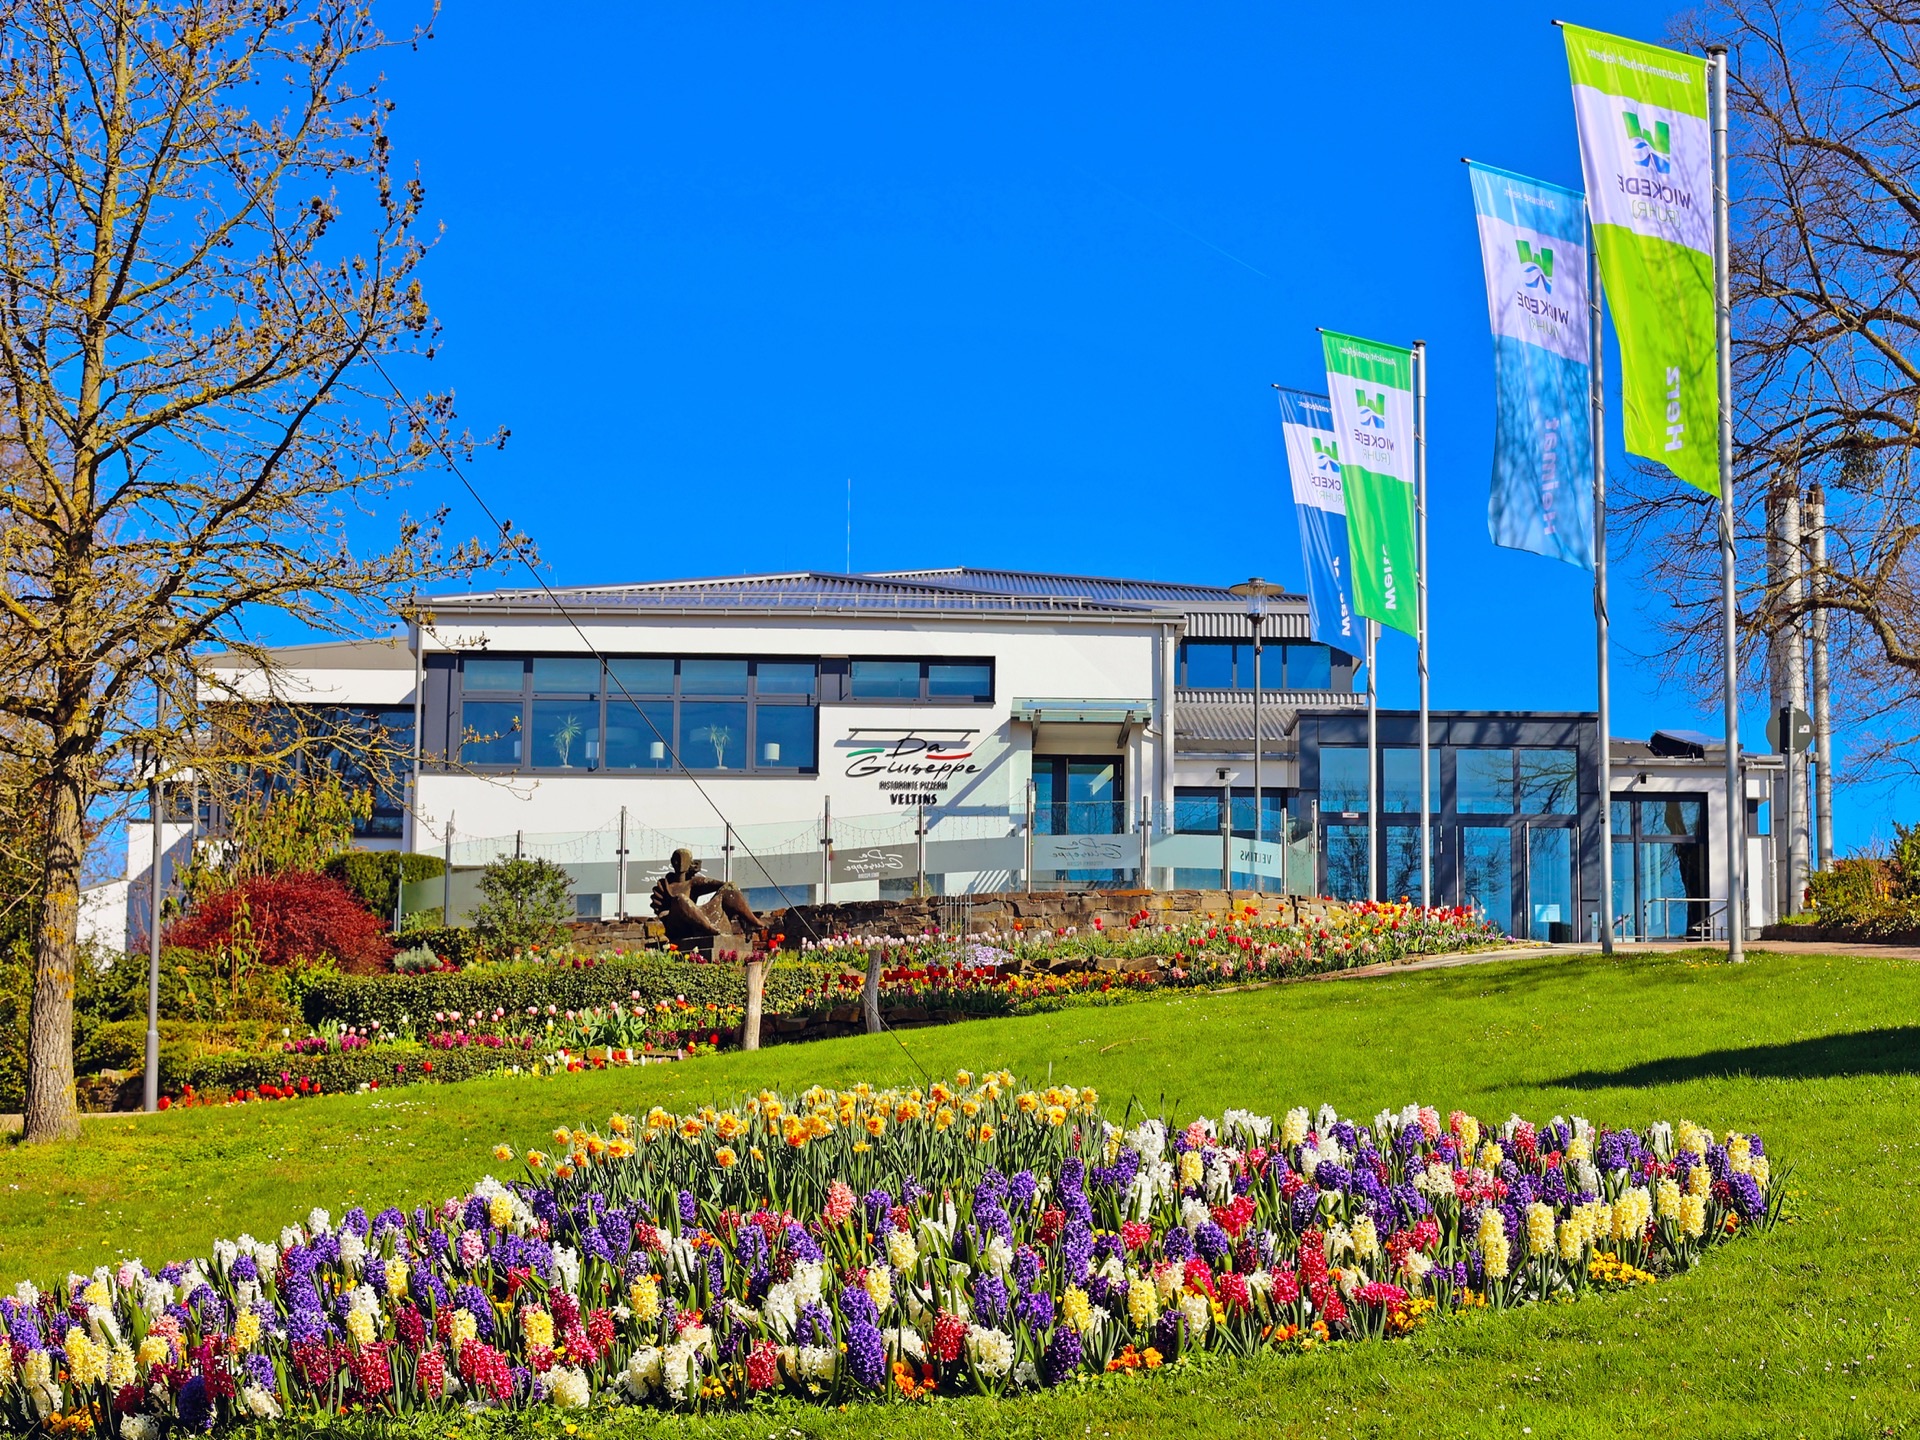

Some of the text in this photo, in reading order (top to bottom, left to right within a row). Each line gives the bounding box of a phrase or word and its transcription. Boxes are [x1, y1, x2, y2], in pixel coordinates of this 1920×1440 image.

[885, 738, 947, 759] Da
[845, 755, 982, 781] Giuseppe
[879, 780, 948, 791] RISTORANTE PIZZERIA
[889, 793, 938, 806] VELTINS
